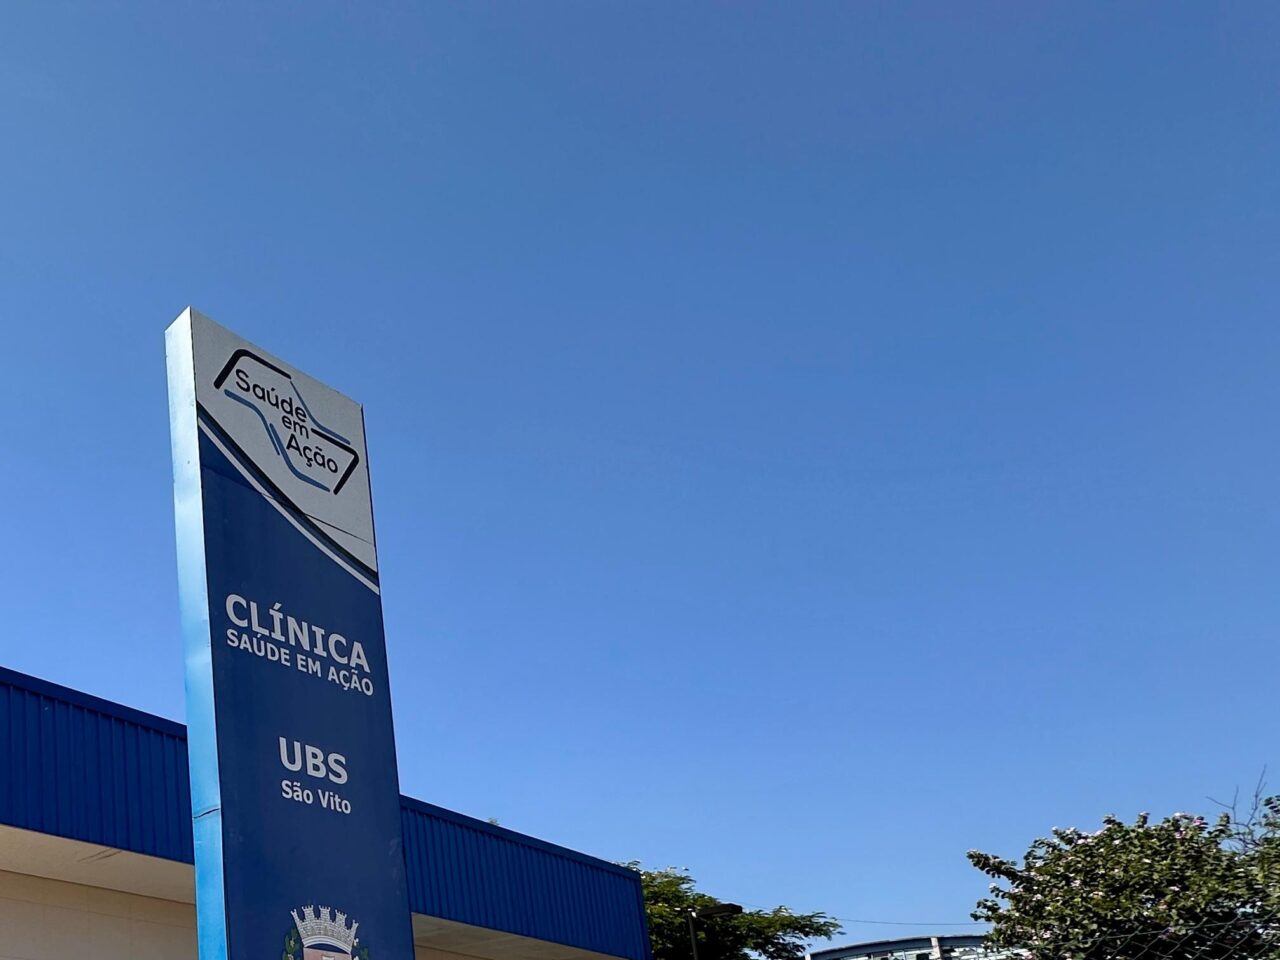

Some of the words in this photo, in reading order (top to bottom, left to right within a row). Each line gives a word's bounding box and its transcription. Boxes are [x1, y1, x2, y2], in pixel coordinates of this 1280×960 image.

[235, 368, 307, 423] Saúde
[281, 416, 309, 439] em
[286, 434, 339, 474] Ação
[225, 593, 371, 674] CLÍNICA
[226, 628, 291, 666] SAÚDE
[296, 653, 321, 678] EM
[327, 668, 374, 696] AÇÃO
[278, 736, 348, 785] UBS
[281, 779, 313, 804] São
[318, 788, 352, 814] Vito
